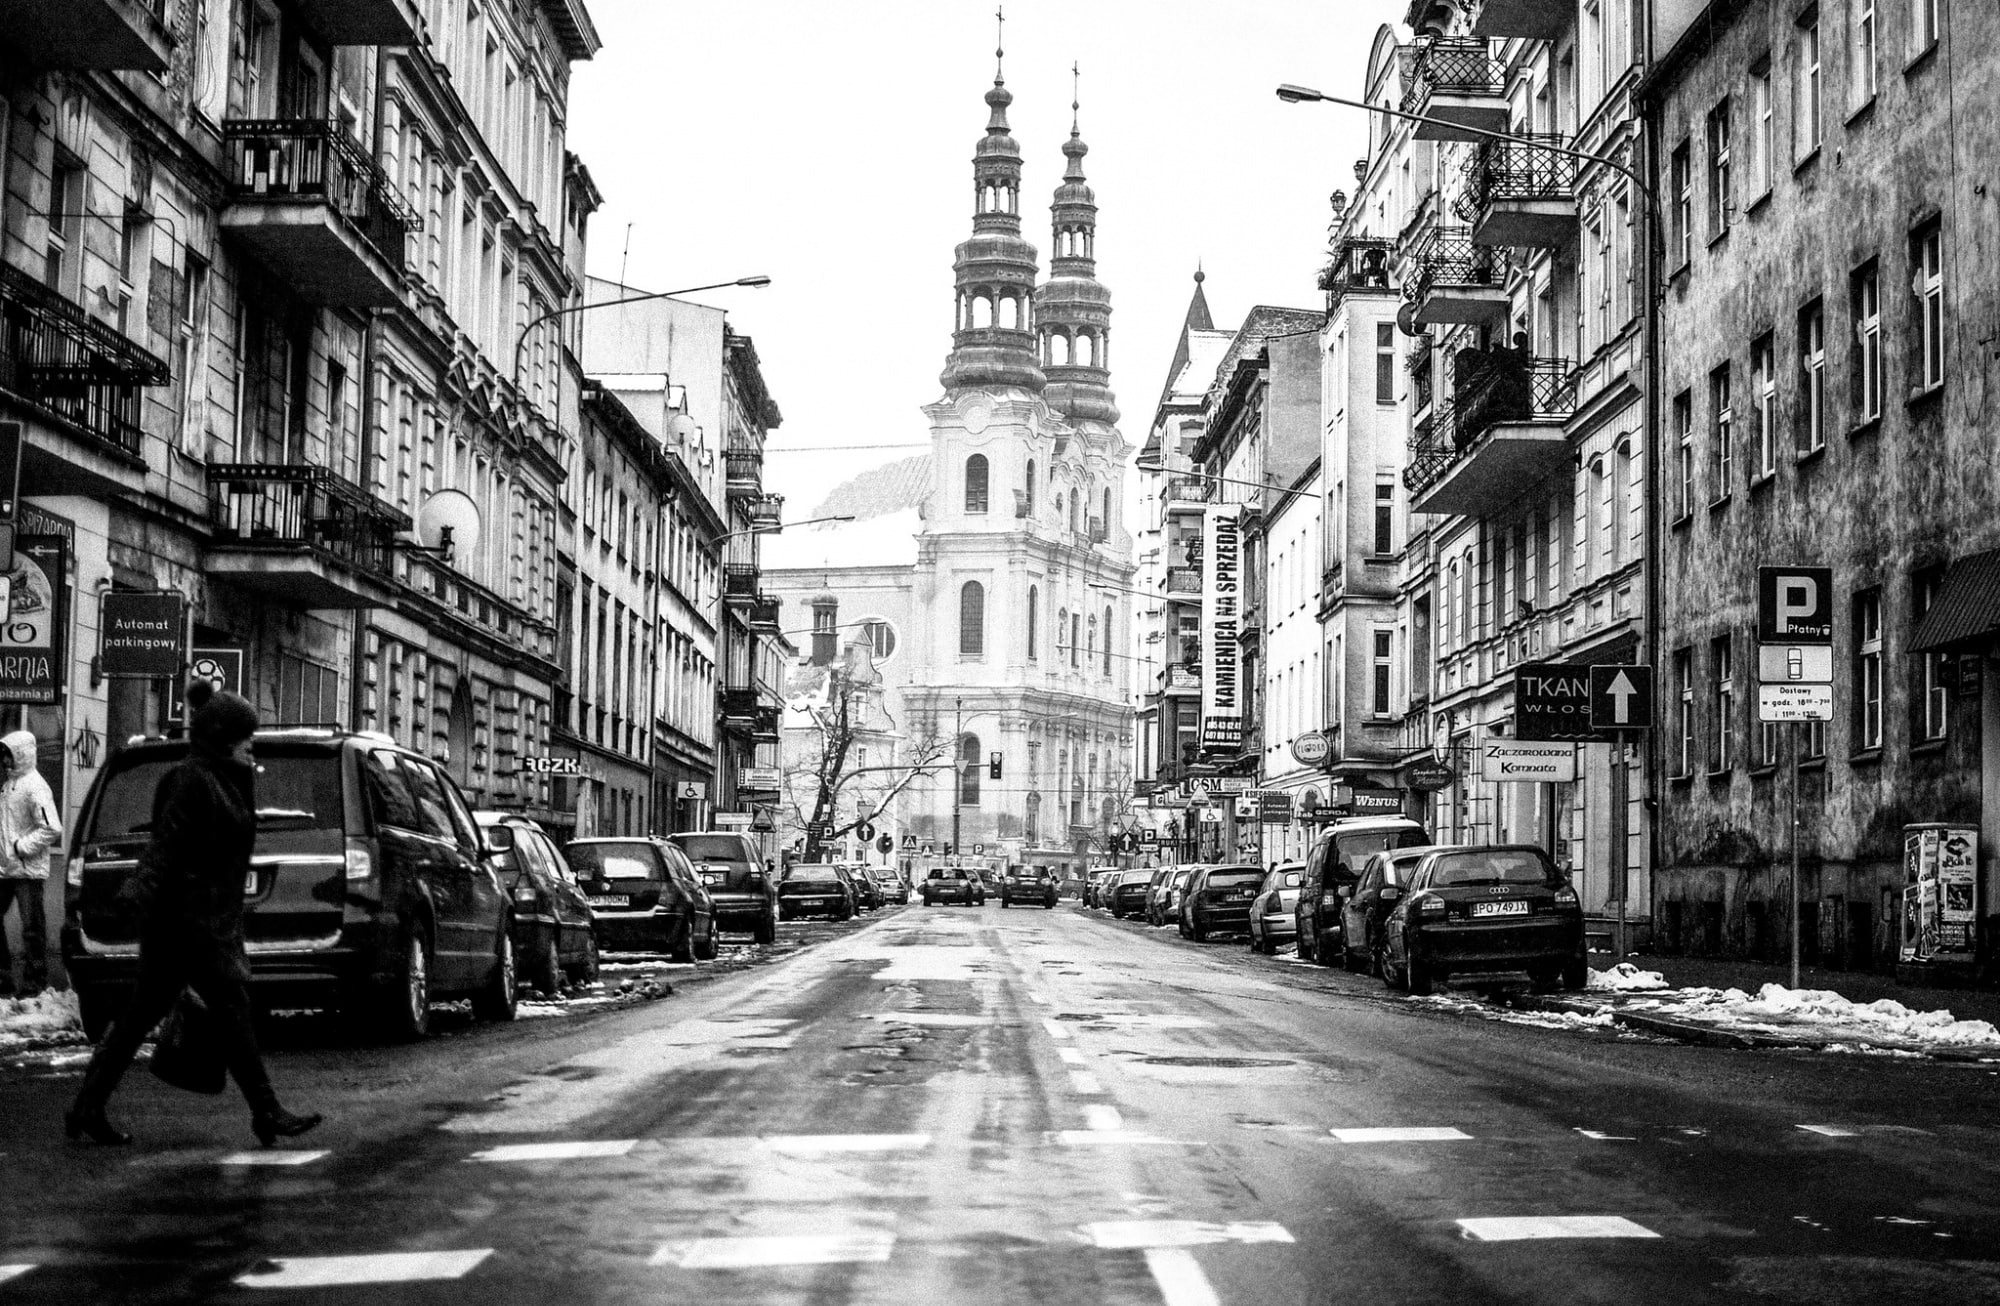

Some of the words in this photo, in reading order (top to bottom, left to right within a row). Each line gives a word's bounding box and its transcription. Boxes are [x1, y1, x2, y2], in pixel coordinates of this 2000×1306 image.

[1212, 515, 1239, 592] SPRZEDAŻ
[1214, 596, 1237, 616] NA
[1776, 576, 1817, 633] P
[115, 618, 168, 630] Automat
[1788, 624, 1821, 636] Płatny
[105, 636, 176, 650] parkingowy
[1214, 620, 1237, 707] KAMIENICA
[1486, 745, 1573, 759] Zaczarowana
[1501, 762, 1557, 774] Komnata
[1191, 778, 1222, 792] GSM
[1355, 795, 1399, 807] WENUS
[1478, 903, 1494, 914] PO
[1496, 901, 1528, 912] 749JX
